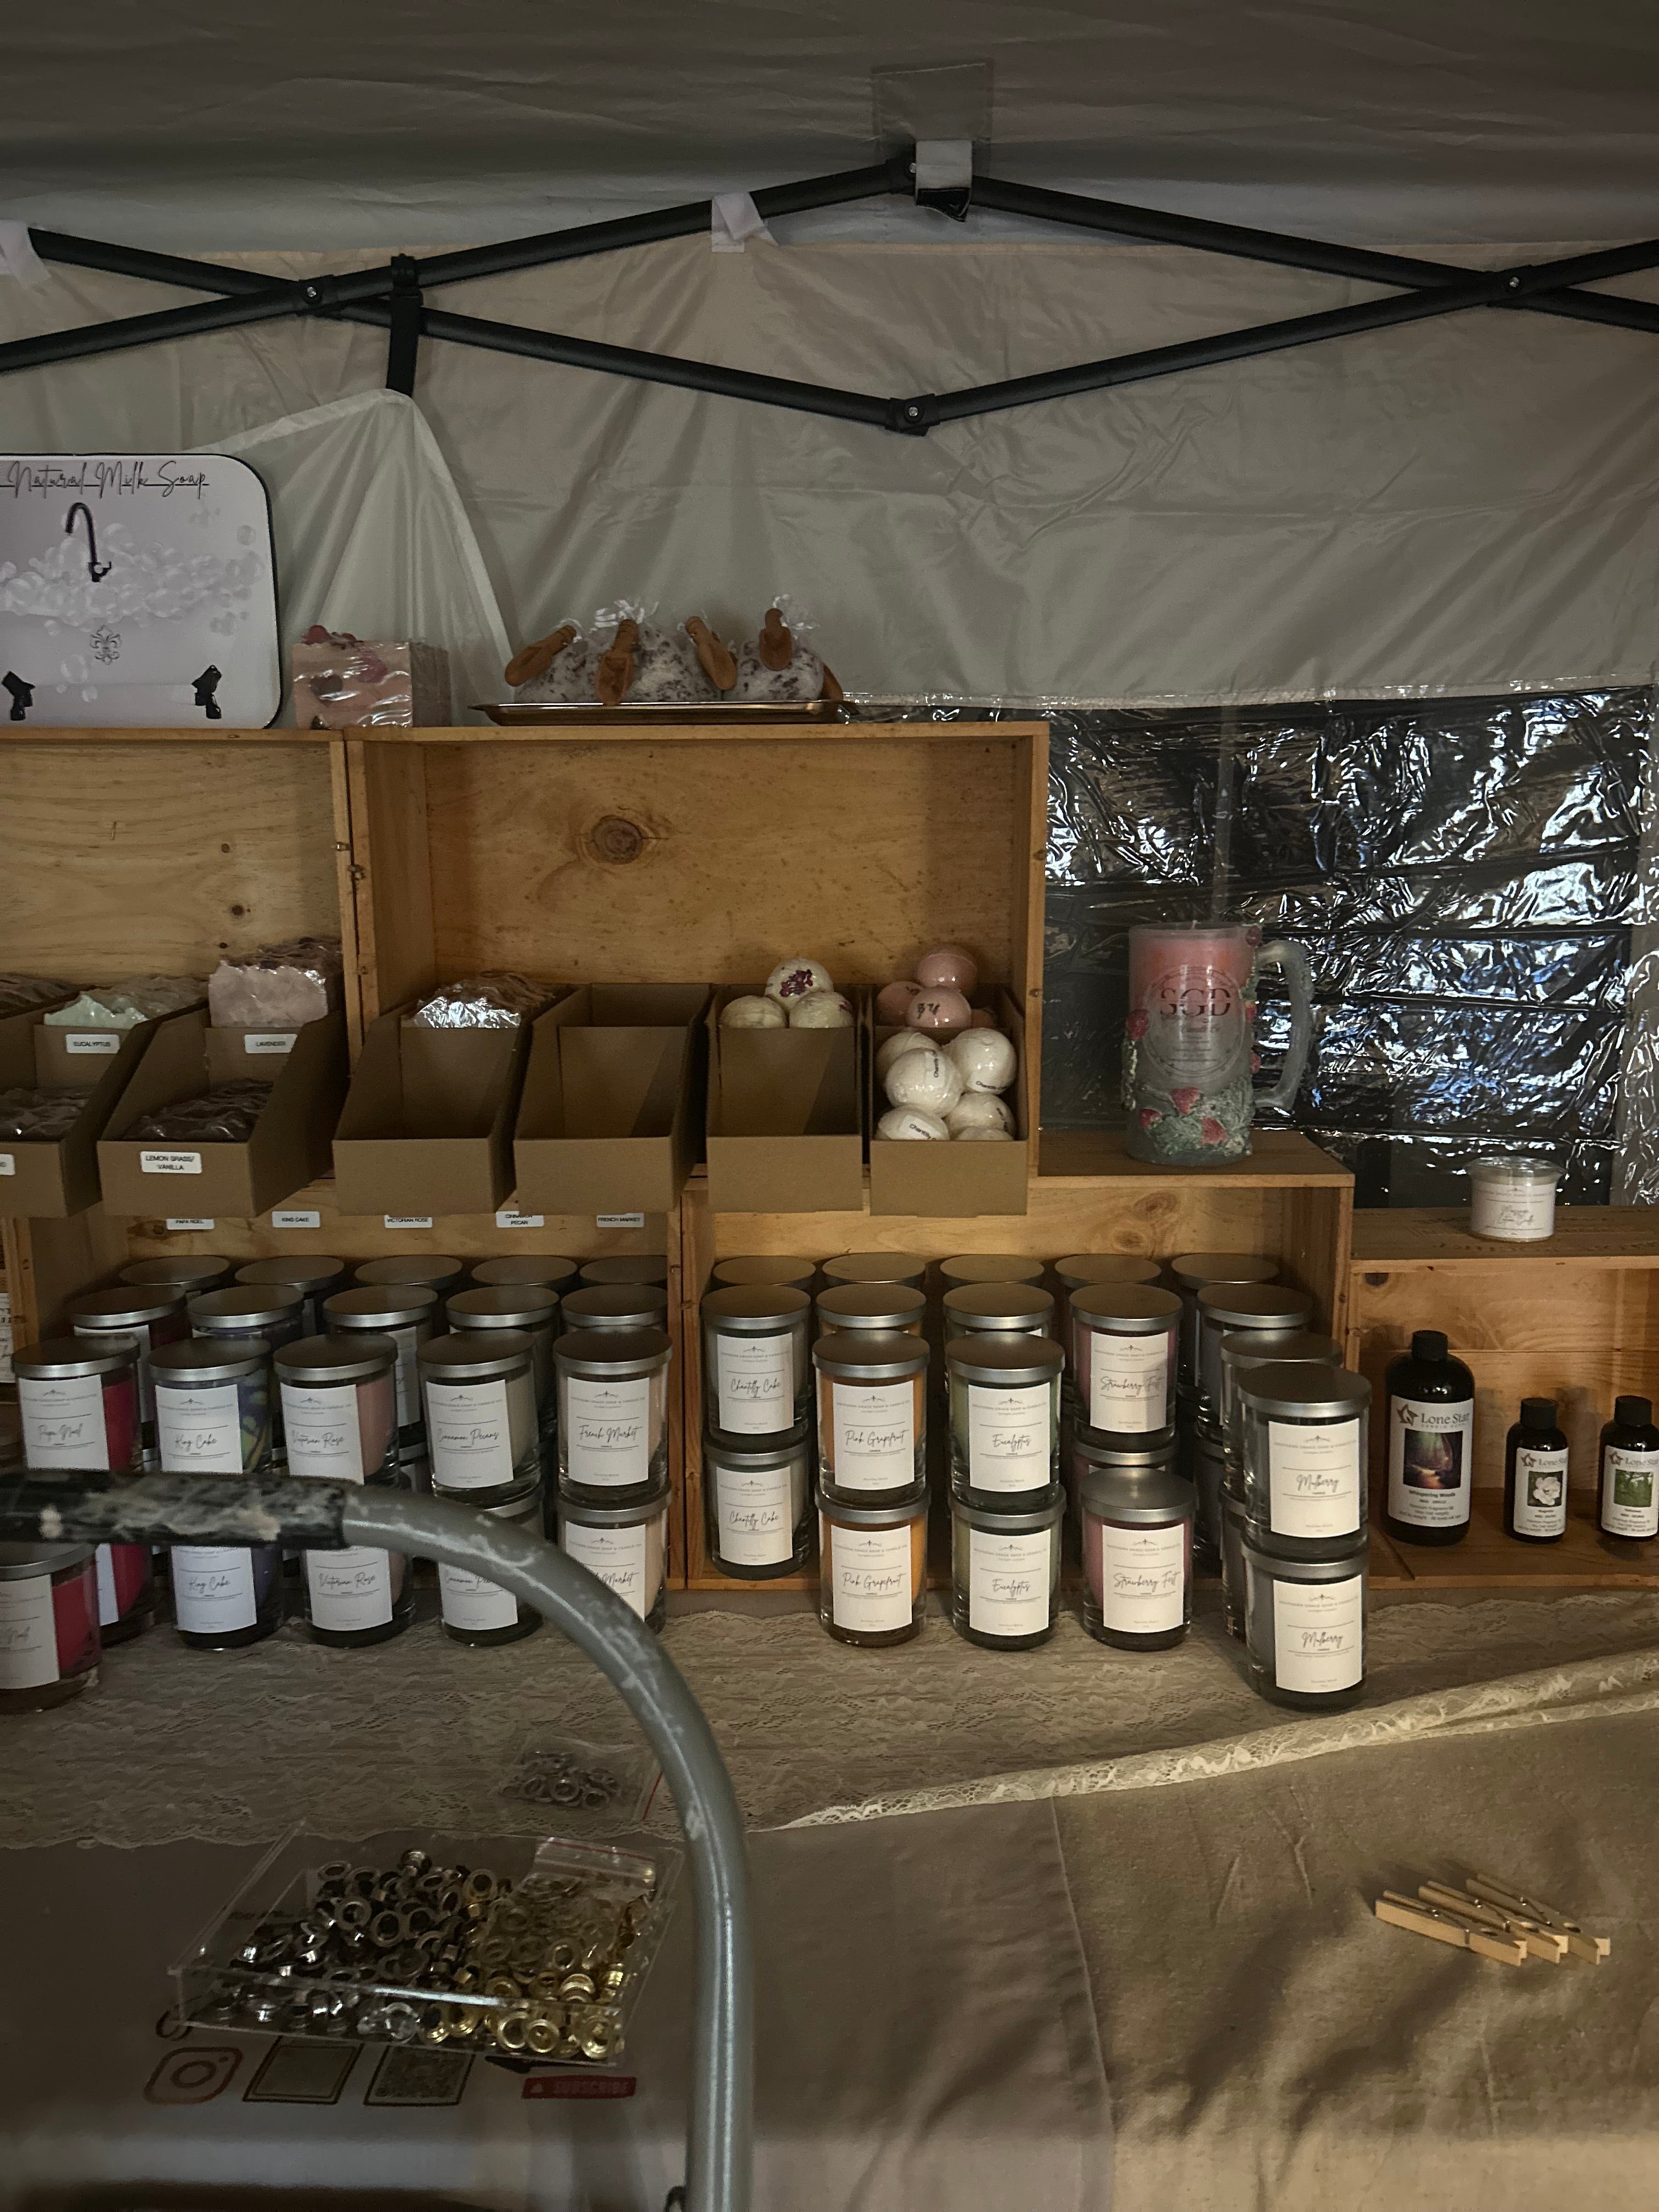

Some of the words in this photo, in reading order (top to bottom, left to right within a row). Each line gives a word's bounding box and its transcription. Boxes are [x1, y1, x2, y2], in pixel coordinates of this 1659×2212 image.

[8, 461, 88, 498] Natural
[95, 461, 149, 498] Milk
[158, 460, 206, 500] Soap
[1160, 988, 1231, 1016] SGD
[730, 1378, 760, 1397] Chantilly
[763, 1378, 781, 1392] Cake
[1100, 1376, 1144, 1396] Strawberry
[1421, 1413, 1451, 1424] Lone
[1452, 1412, 1471, 1424] Star
[196, 1433, 217, 1449] Cake
[579, 1425, 605, 1440] French
[606, 1426, 643, 1443] Market
[845, 1430, 865, 1446] Pink
[867, 1429, 910, 1447] Grapefruit
[992, 1434, 1032, 1452] Eucalyptus
[729, 1510, 759, 1529] Chantilly
[761, 1511, 780, 1526] Cake
[210, 1576, 231, 1590] Cake
[842, 1572, 861, 1587] Pink
[863, 1573, 907, 1592] Grapefruit
[992, 1578, 1031, 1598] Eucalyptus
[1113, 1572, 1159, 1593] Strawberry
